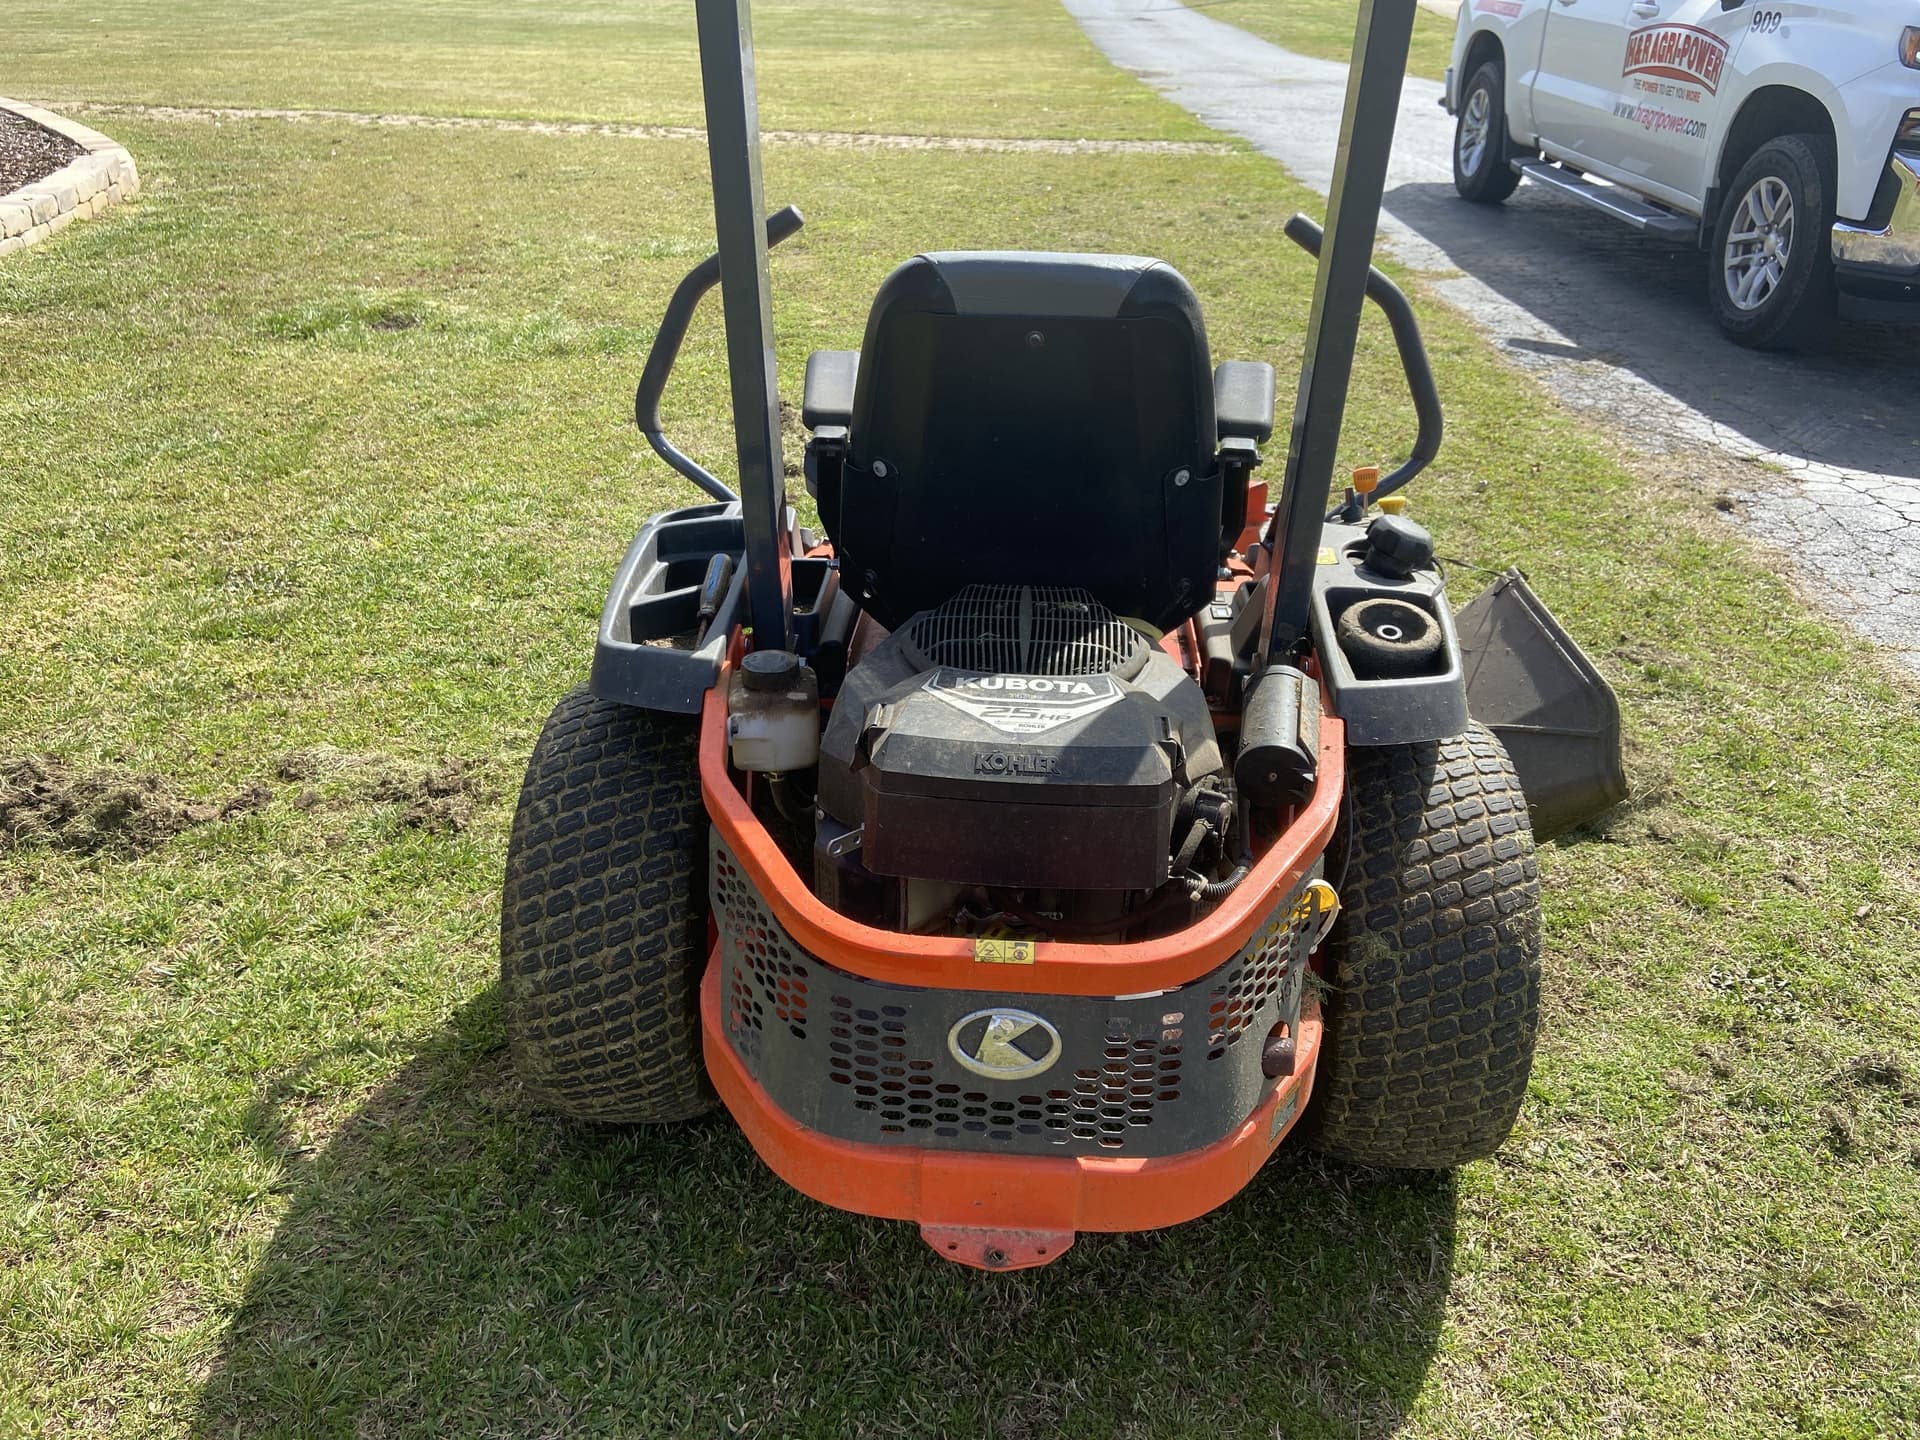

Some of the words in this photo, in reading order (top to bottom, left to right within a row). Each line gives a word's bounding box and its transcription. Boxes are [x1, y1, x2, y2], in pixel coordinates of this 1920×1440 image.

[1751, 10, 1782, 34] 909
[1649, 31, 1724, 85] AGRI-POWER
[955, 677, 1096, 696] KUBOTA
[974, 751, 1060, 777] KOHLER
